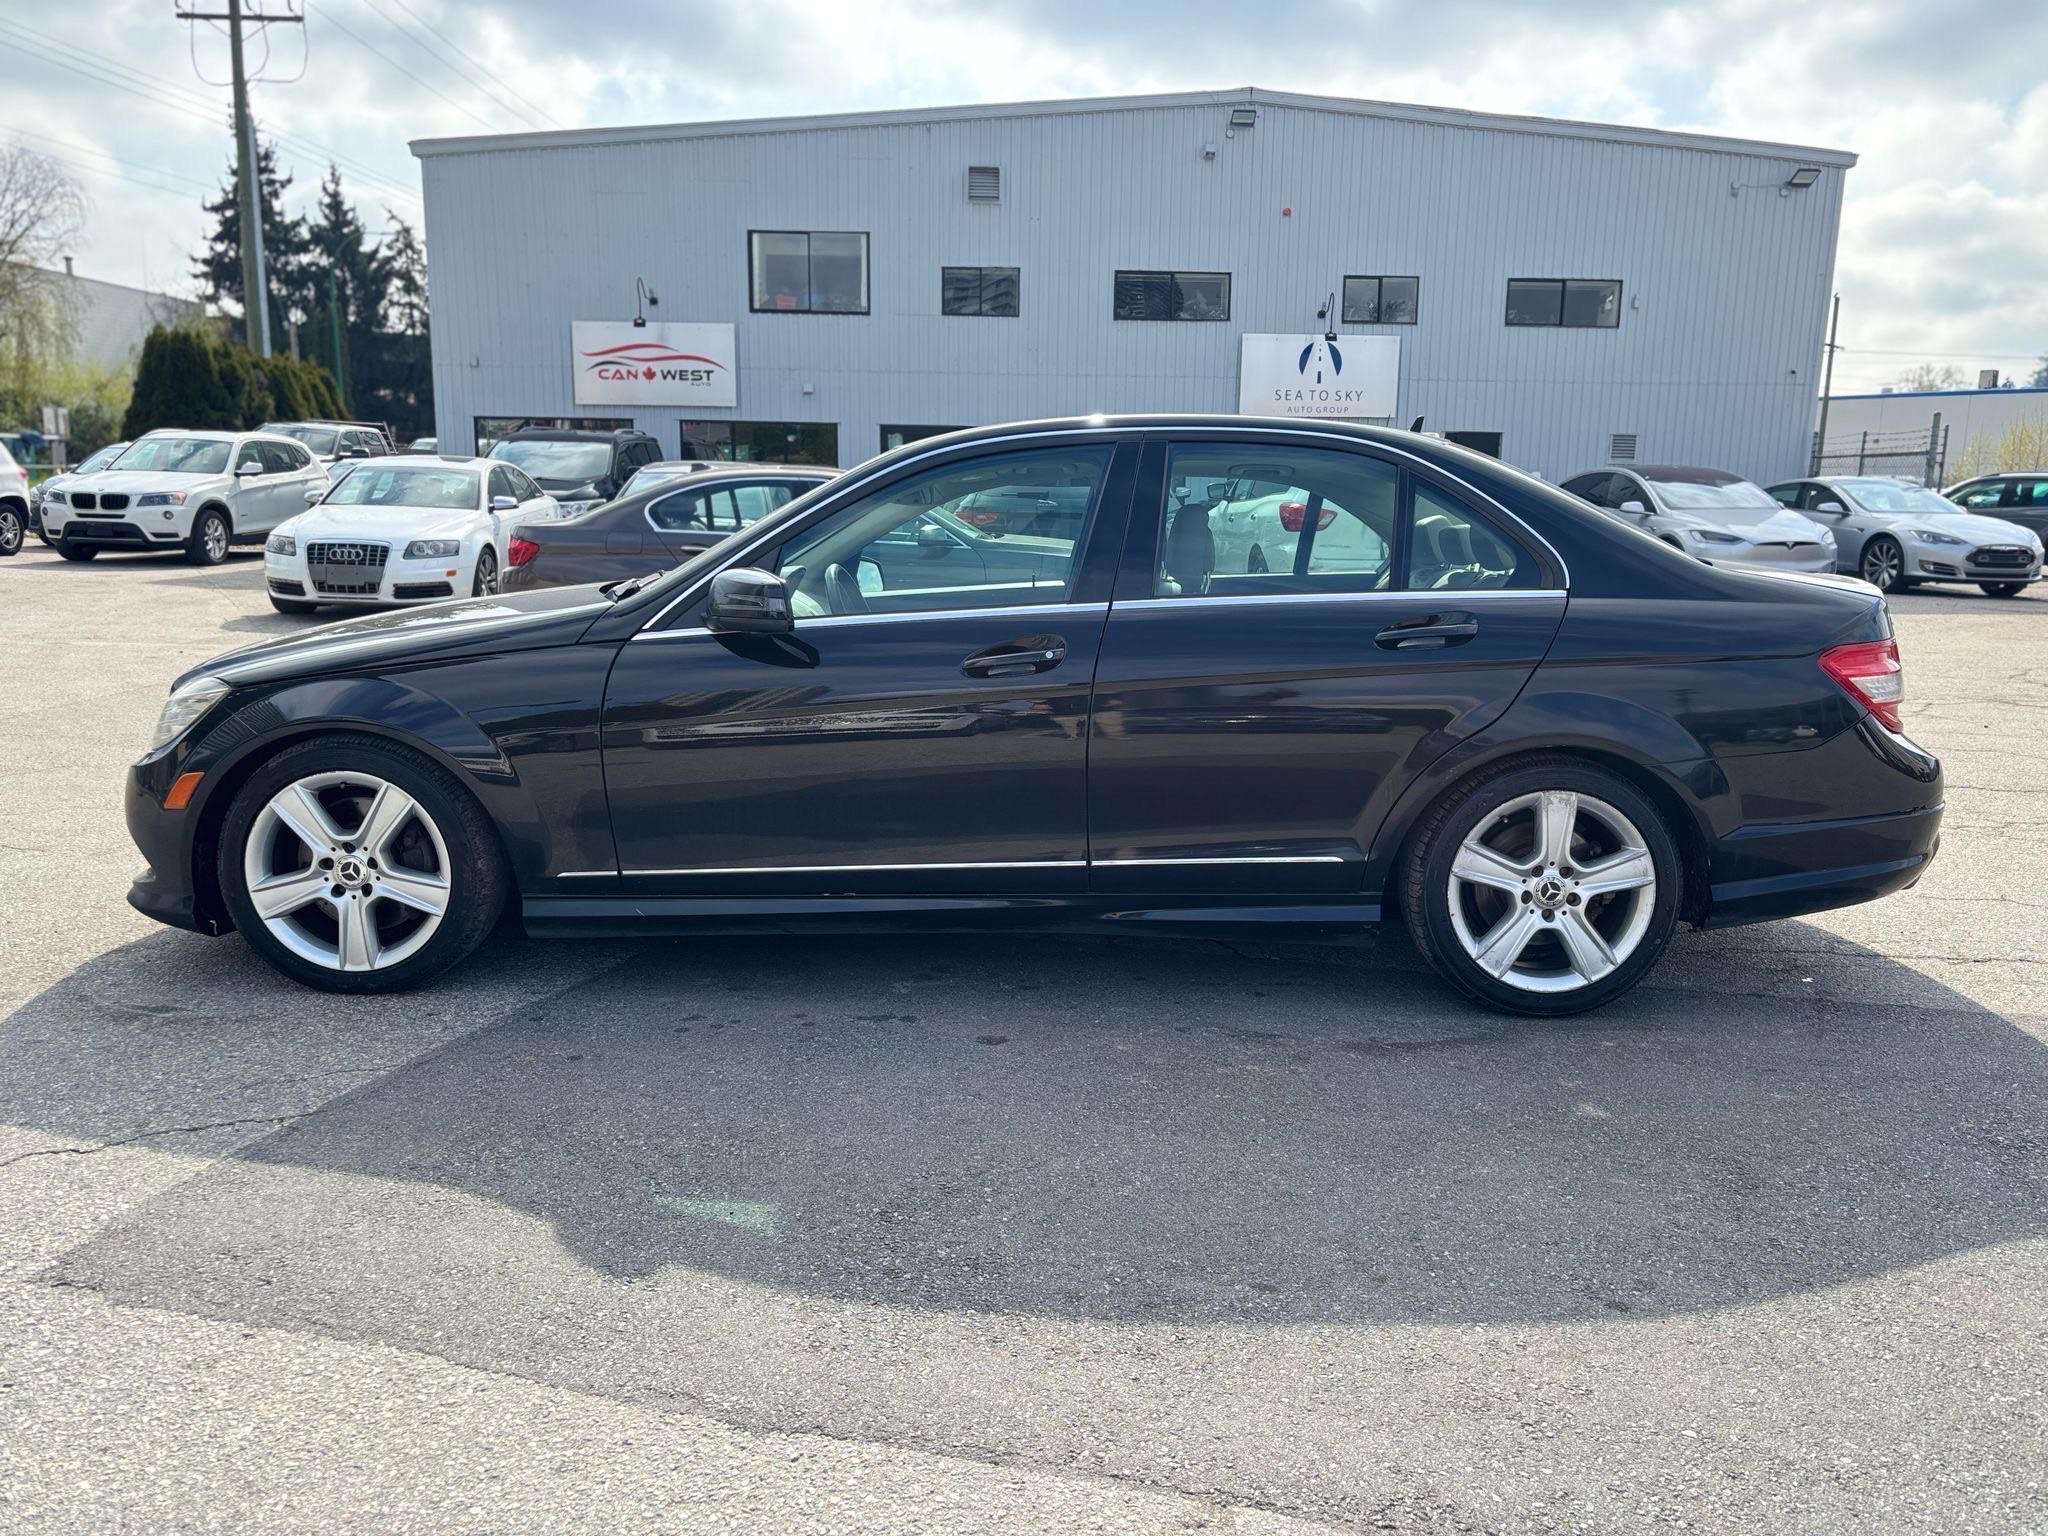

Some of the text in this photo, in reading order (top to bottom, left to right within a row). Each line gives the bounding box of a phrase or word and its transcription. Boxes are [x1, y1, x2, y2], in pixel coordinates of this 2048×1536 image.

[598, 369, 715, 381] CAN WEST
[1274, 389, 1364, 402] SEA TO SKY
[1315, 406, 1349, 414] GROUP
